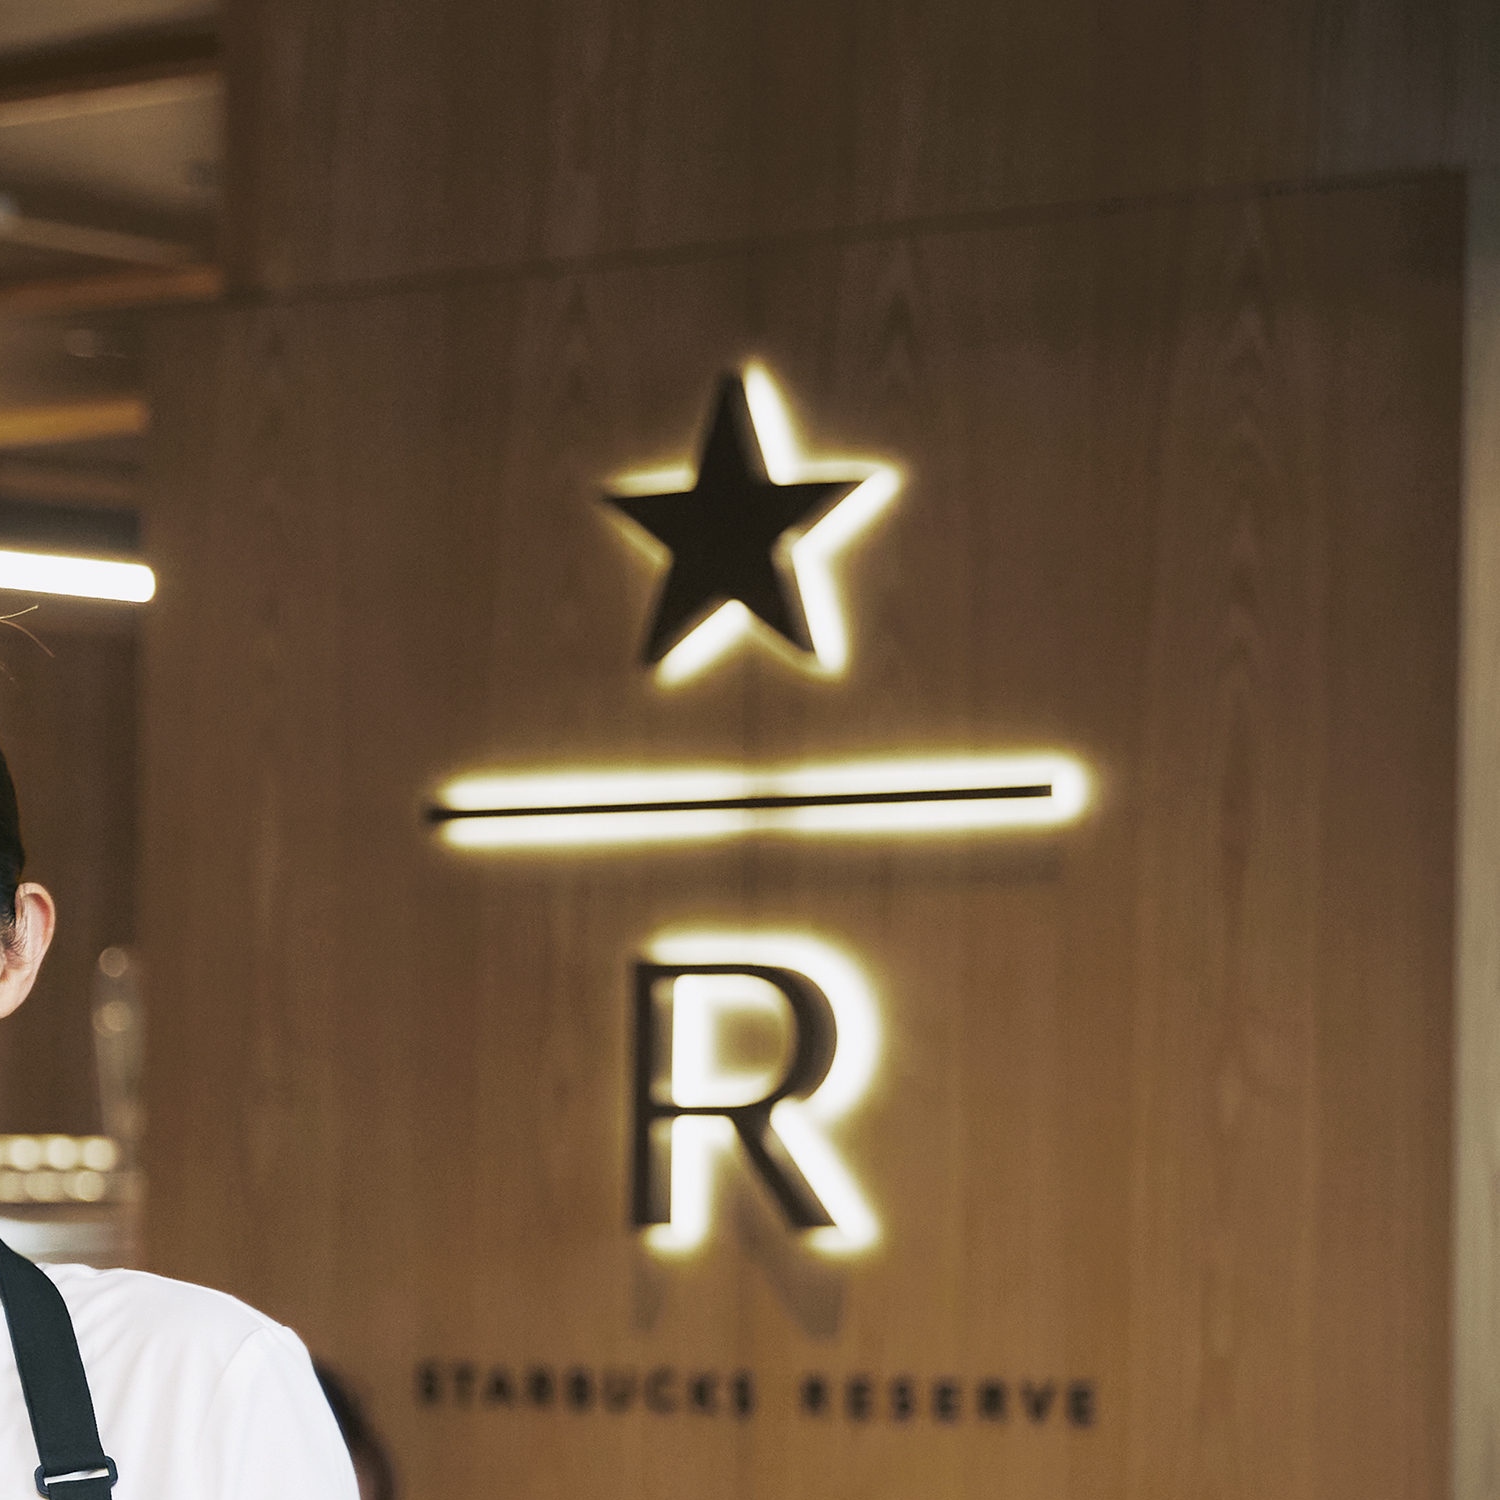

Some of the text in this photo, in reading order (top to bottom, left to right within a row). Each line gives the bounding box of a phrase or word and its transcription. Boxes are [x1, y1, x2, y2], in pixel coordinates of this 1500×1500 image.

[632, 942, 866, 1244] R
[413, 1359, 1093, 1428] STARBUCKS RESERVE
